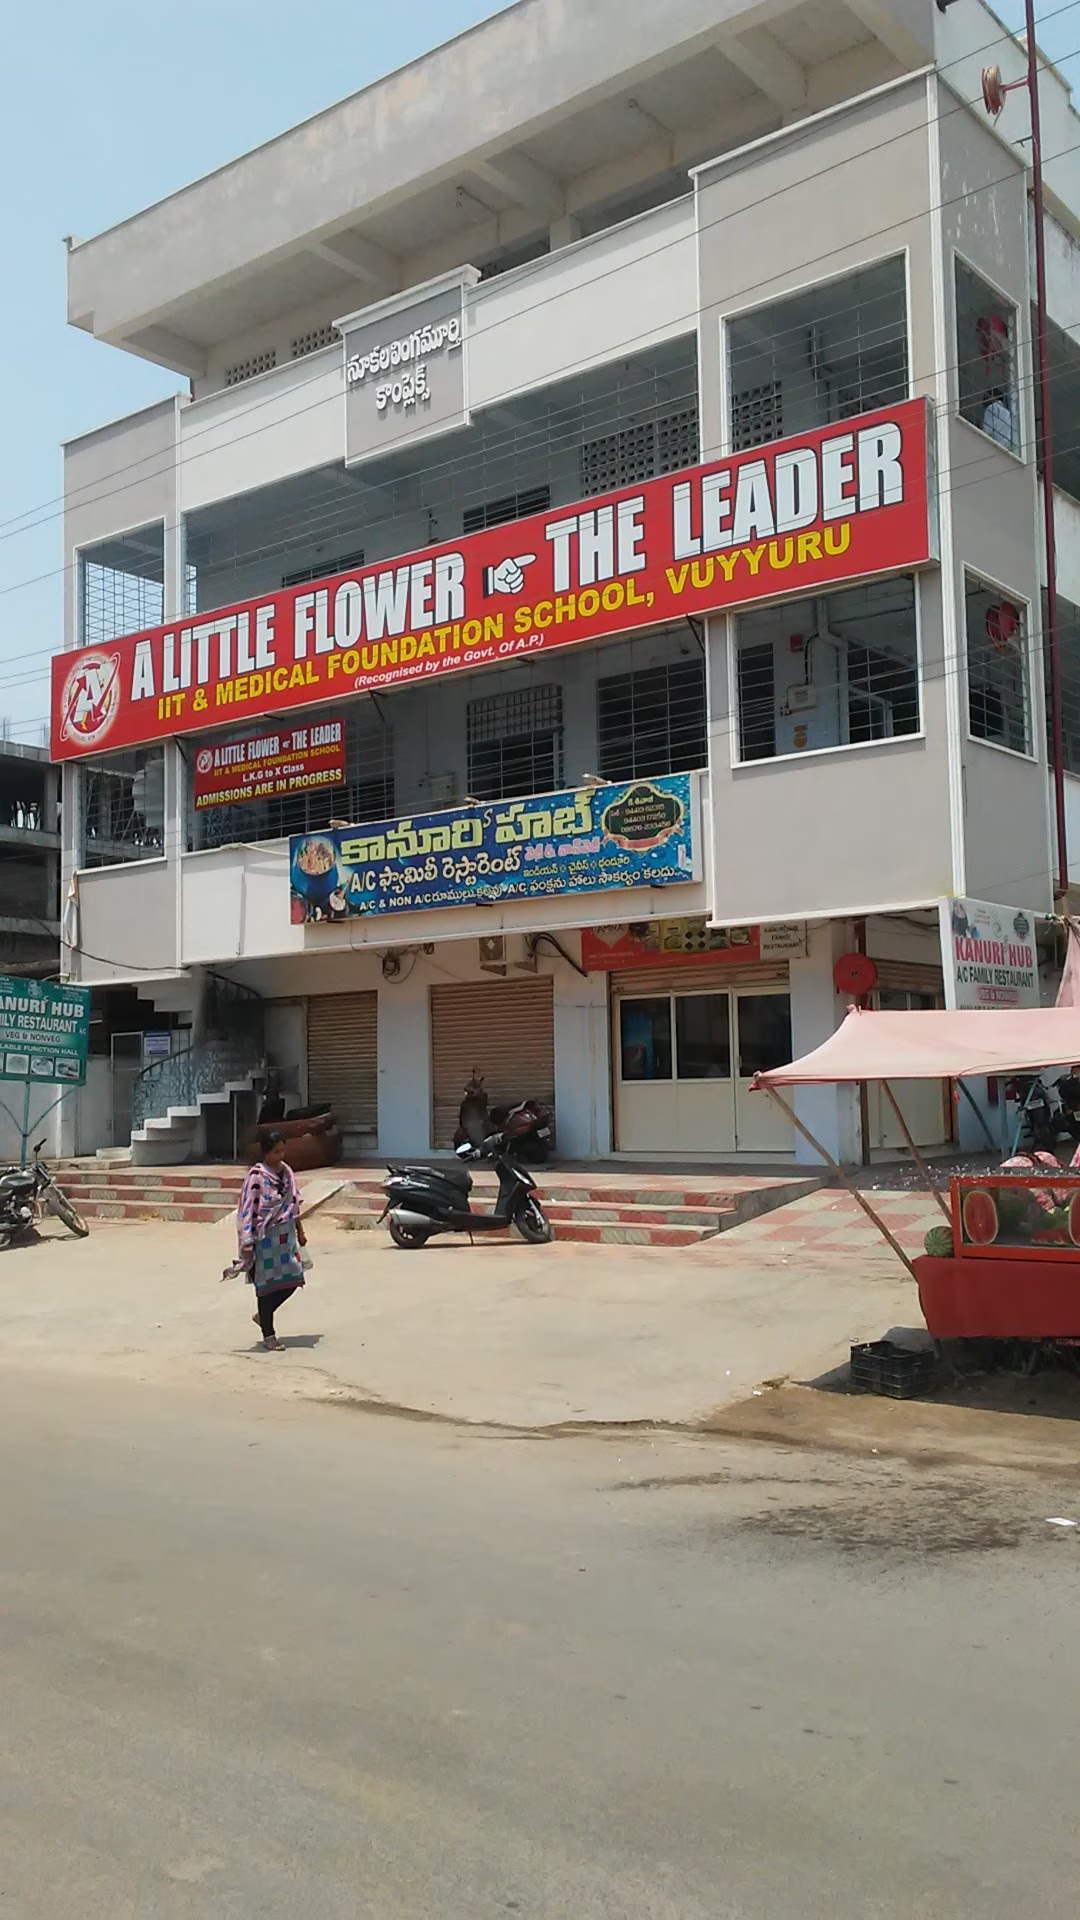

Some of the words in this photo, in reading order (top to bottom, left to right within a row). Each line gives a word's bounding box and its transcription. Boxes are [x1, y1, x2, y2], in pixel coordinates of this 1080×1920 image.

[131, 638, 156, 701] A
[163, 604, 276, 693] LITTLE
[295, 553, 465, 660] FLOWER
[546, 496, 647, 593] THE
[673, 422, 904, 561] LEADER
[158, 693, 185, 719] IIT
[193, 688, 209, 711] &
[216, 665, 320, 707] MEDICAL
[328, 615, 504, 676] FOUNDATION
[514, 582, 655, 634] SCHOOL,
[665, 523, 852, 595] VUYYURU
[354, 663, 423, 688] (Recognised
[426, 660, 441, 674] by
[443, 655, 461, 667] the
[464, 648, 495, 662] Govt.
[499, 641, 515, 654] Of
[516, 633, 544, 649] A.P.)
[214, 748, 221, 767] A
[221, 744, 245, 766] LITTLE
[248, 736, 280, 760] FLOWER
[292, 729, 308, 750] THE
[311, 723, 341, 746] LEADER
[232, 761, 262, 774] MEDICAL
[263, 751, 309, 767] FOUNDATION
[310, 744, 340, 757] SCHOOL
[265, 769, 274, 778] to
[275, 767, 281, 775] X
[282, 763, 305, 775] Class
[196, 785, 252, 808] ADMISSIONS
[254, 781, 274, 796] ARE
[276, 779, 287, 791] IN
[289, 768, 342, 789] PROGRESS
[351, 870, 376, 893] A/C
[360, 900, 376, 911] A/C
[378, 898, 387, 909] &
[389, 895, 412, 907] NON
[955, 936, 1005, 965] KANURI
[1008, 944, 1033, 968] HUB
[994, 968, 1034, 988] RESTAURANT
[52, 1001, 84, 1018] HUB
[0, 1013, 15, 1027] ILY
[17, 1014, 78, 1033] RESTAURANT
[5, 1031, 20, 1040] VEG
[29, 1033, 61, 1043] NONVEG
[23, 1045, 60, 1054] FUNCTION
[61, 1048, 79, 1056] HALL
